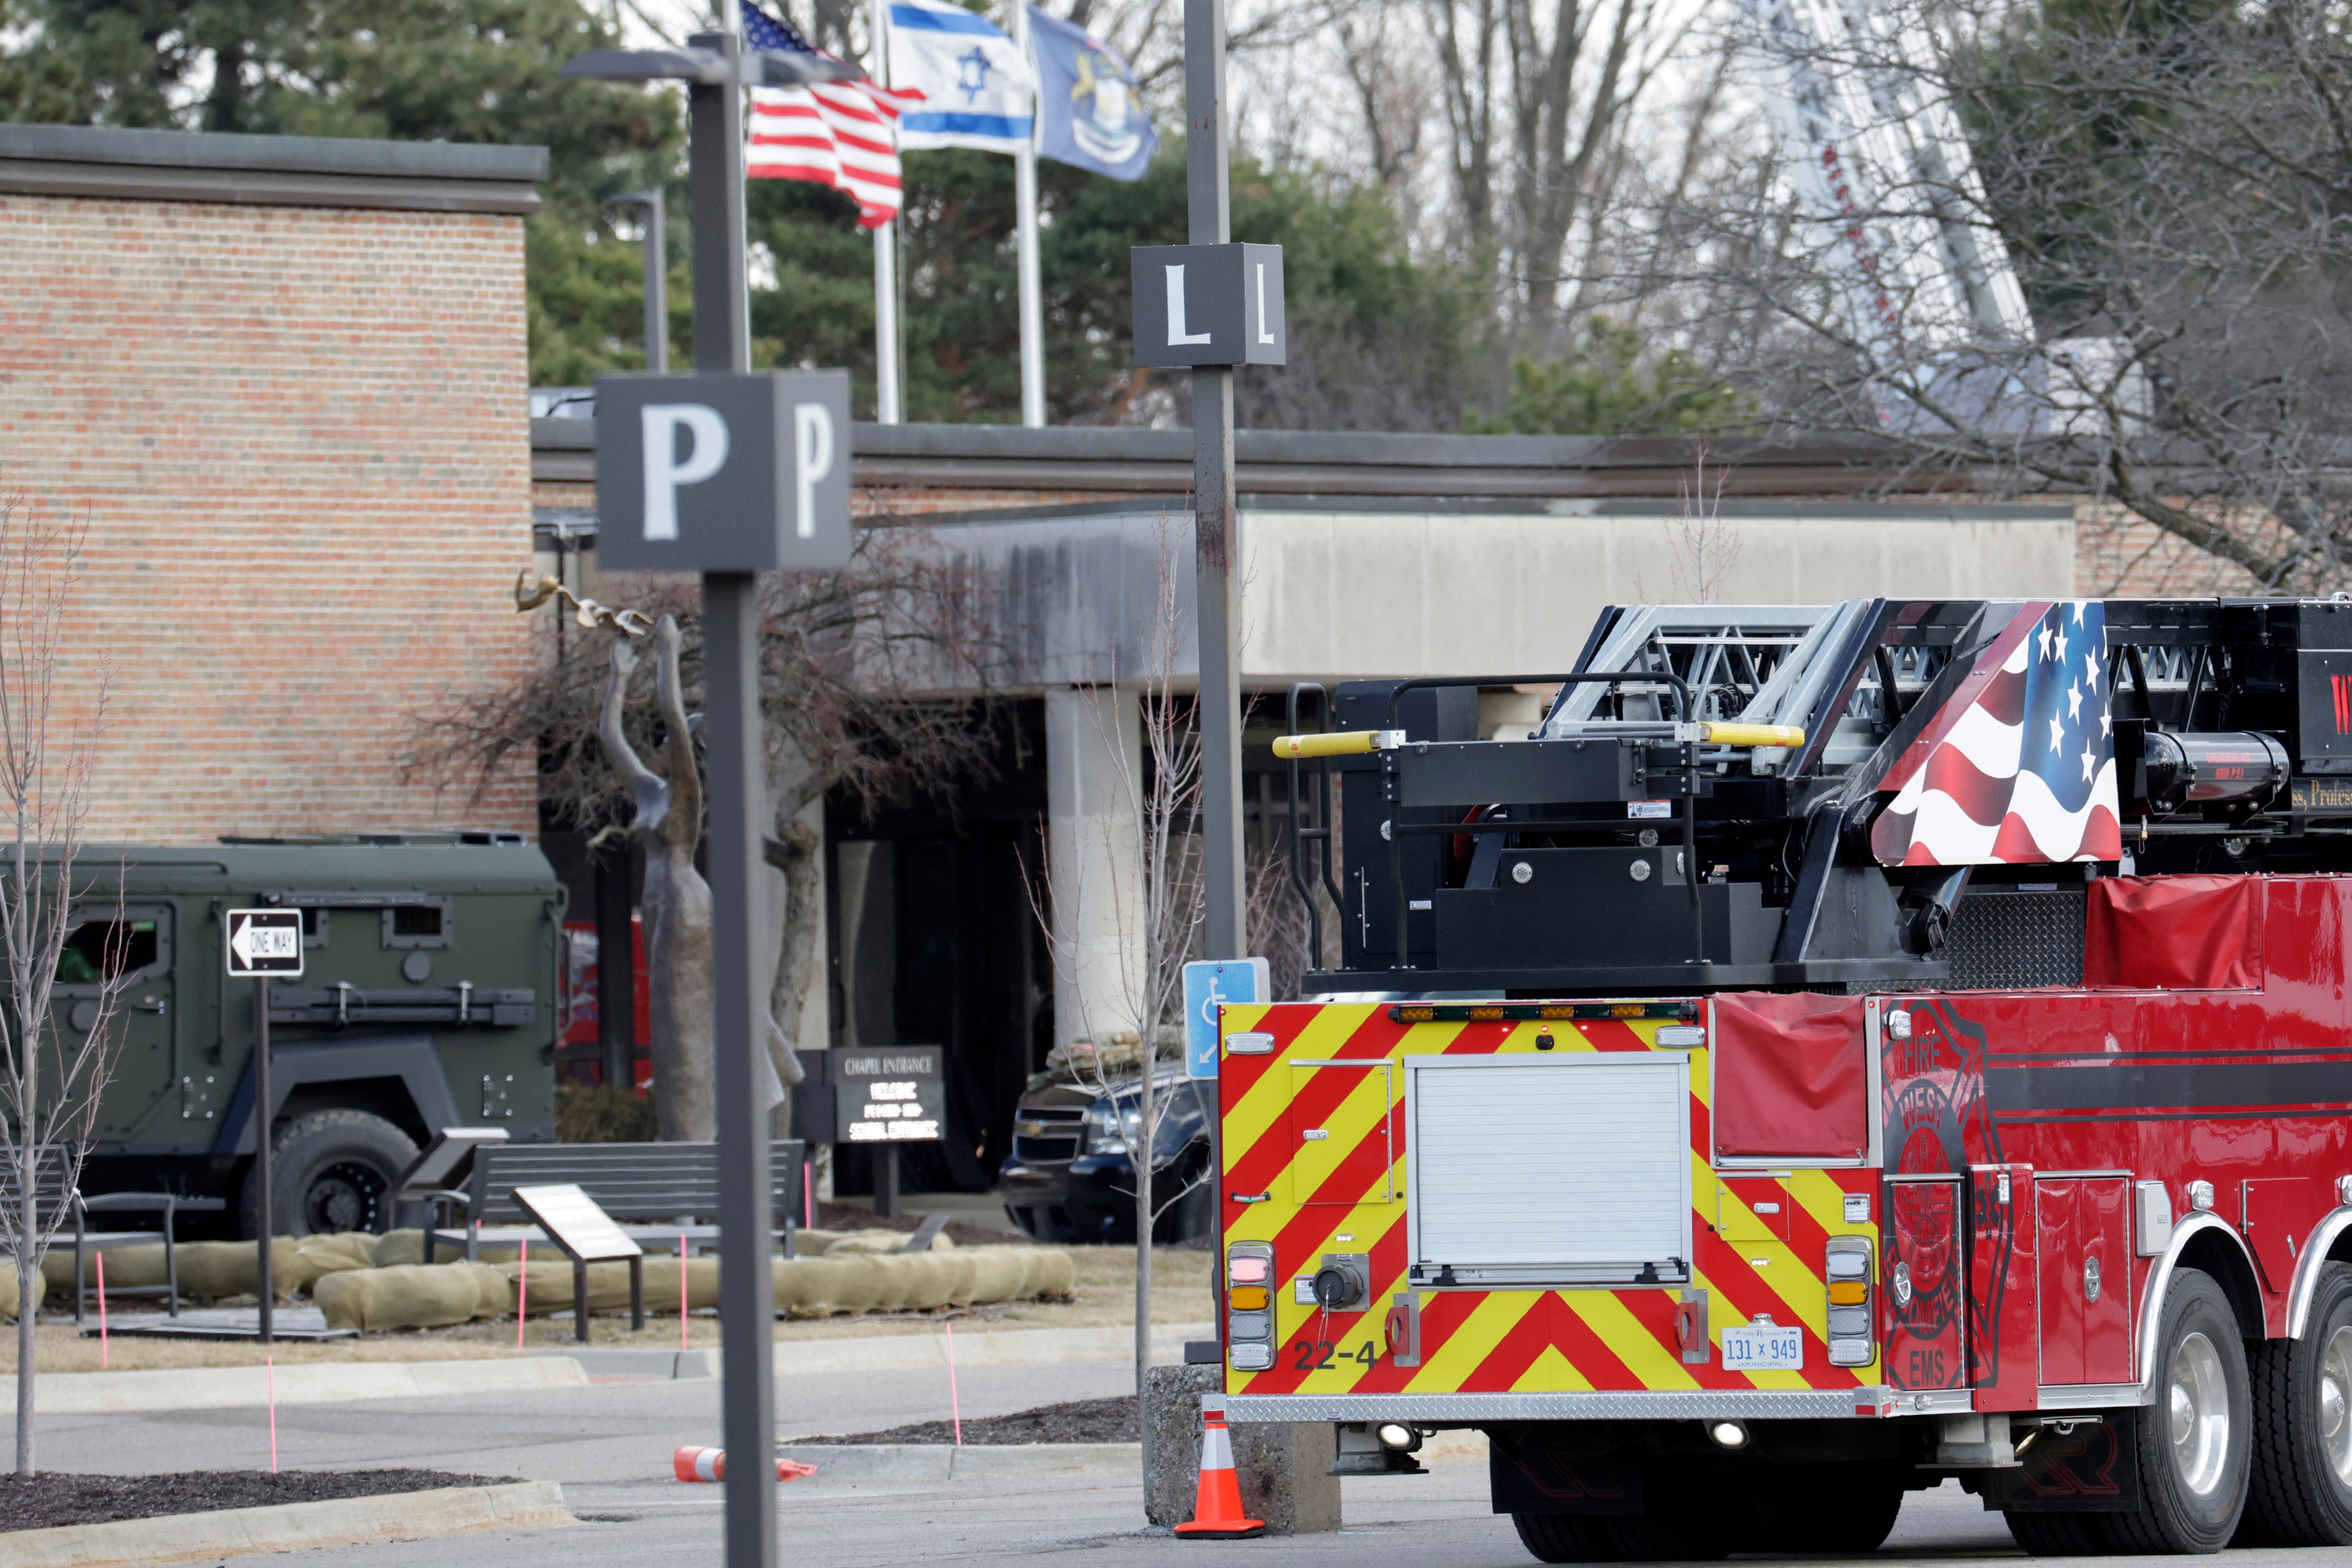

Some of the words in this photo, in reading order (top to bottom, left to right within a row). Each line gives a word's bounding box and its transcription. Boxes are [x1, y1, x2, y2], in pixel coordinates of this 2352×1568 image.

[1165, 264, 1211, 346] L
[1257, 263, 1274, 345] L
[642, 402, 730, 541] P
[794, 402, 834, 539] P
[2230, 767, 2245, 780] PSI
[250, 931, 269, 953] ONE
[273, 931, 293, 953] WAY
[844, 1057, 882, 1076] CHAPEL
[883, 1055, 934, 1074] ENTRANCE
[1904, 1036, 1941, 1073] FIRE
[1899, 1087, 1946, 1132] WEST
[1726, 1339, 1753, 1360] 131
[1771, 1339, 1796, 1359] 949
[1752, 1330, 1780, 1338] MICHIGAN
[1294, 1340, 1379, 1370] 22-4
[1909, 1349, 1944, 1387] EMS
